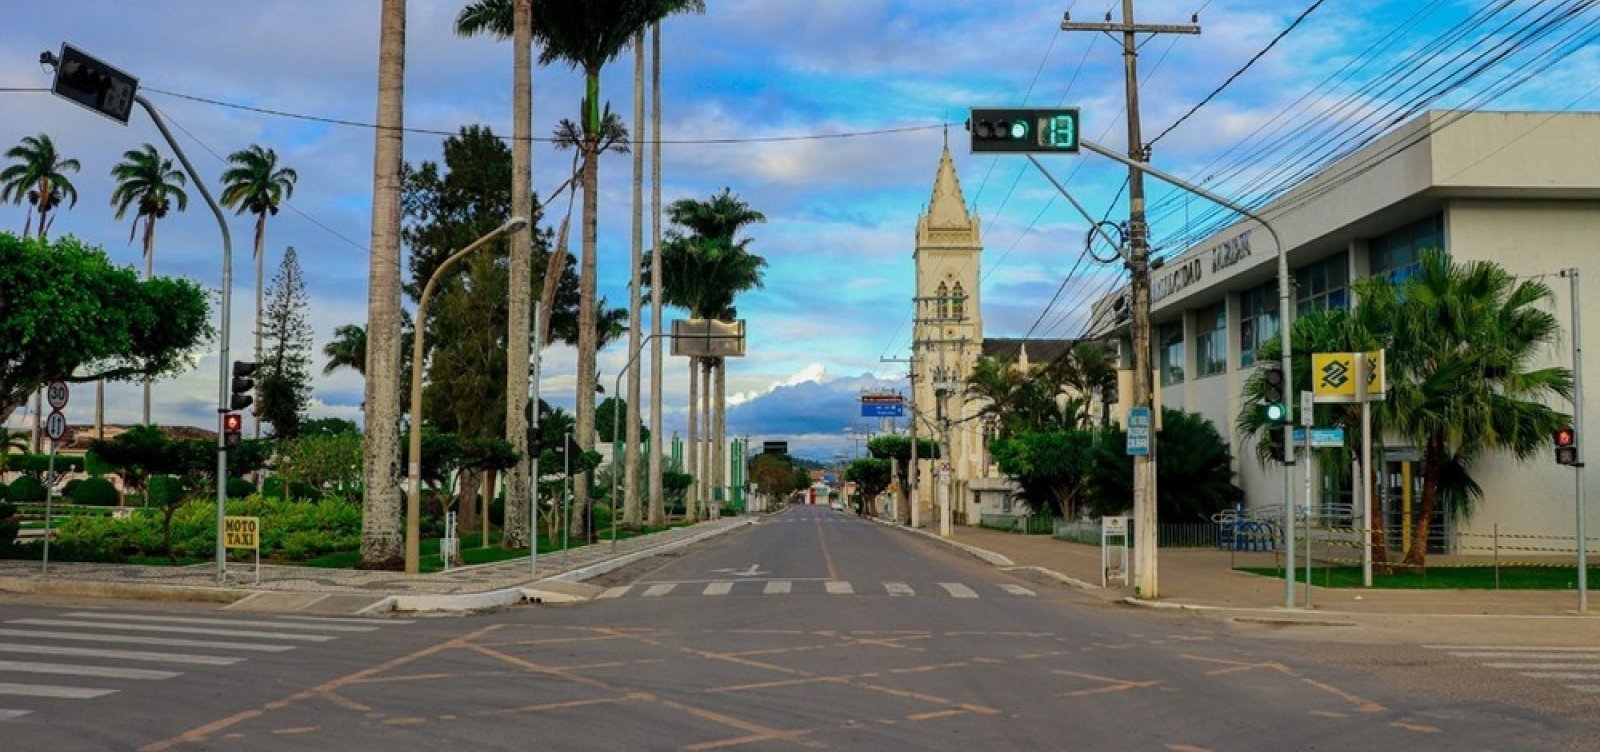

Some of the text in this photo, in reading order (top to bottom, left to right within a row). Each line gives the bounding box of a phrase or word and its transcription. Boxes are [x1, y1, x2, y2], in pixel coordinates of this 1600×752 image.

[1050, 115, 1073, 147] 13
[51, 387, 65, 400] 30
[225, 519, 256, 532] MOTO
[227, 533, 254, 546] TAXI
